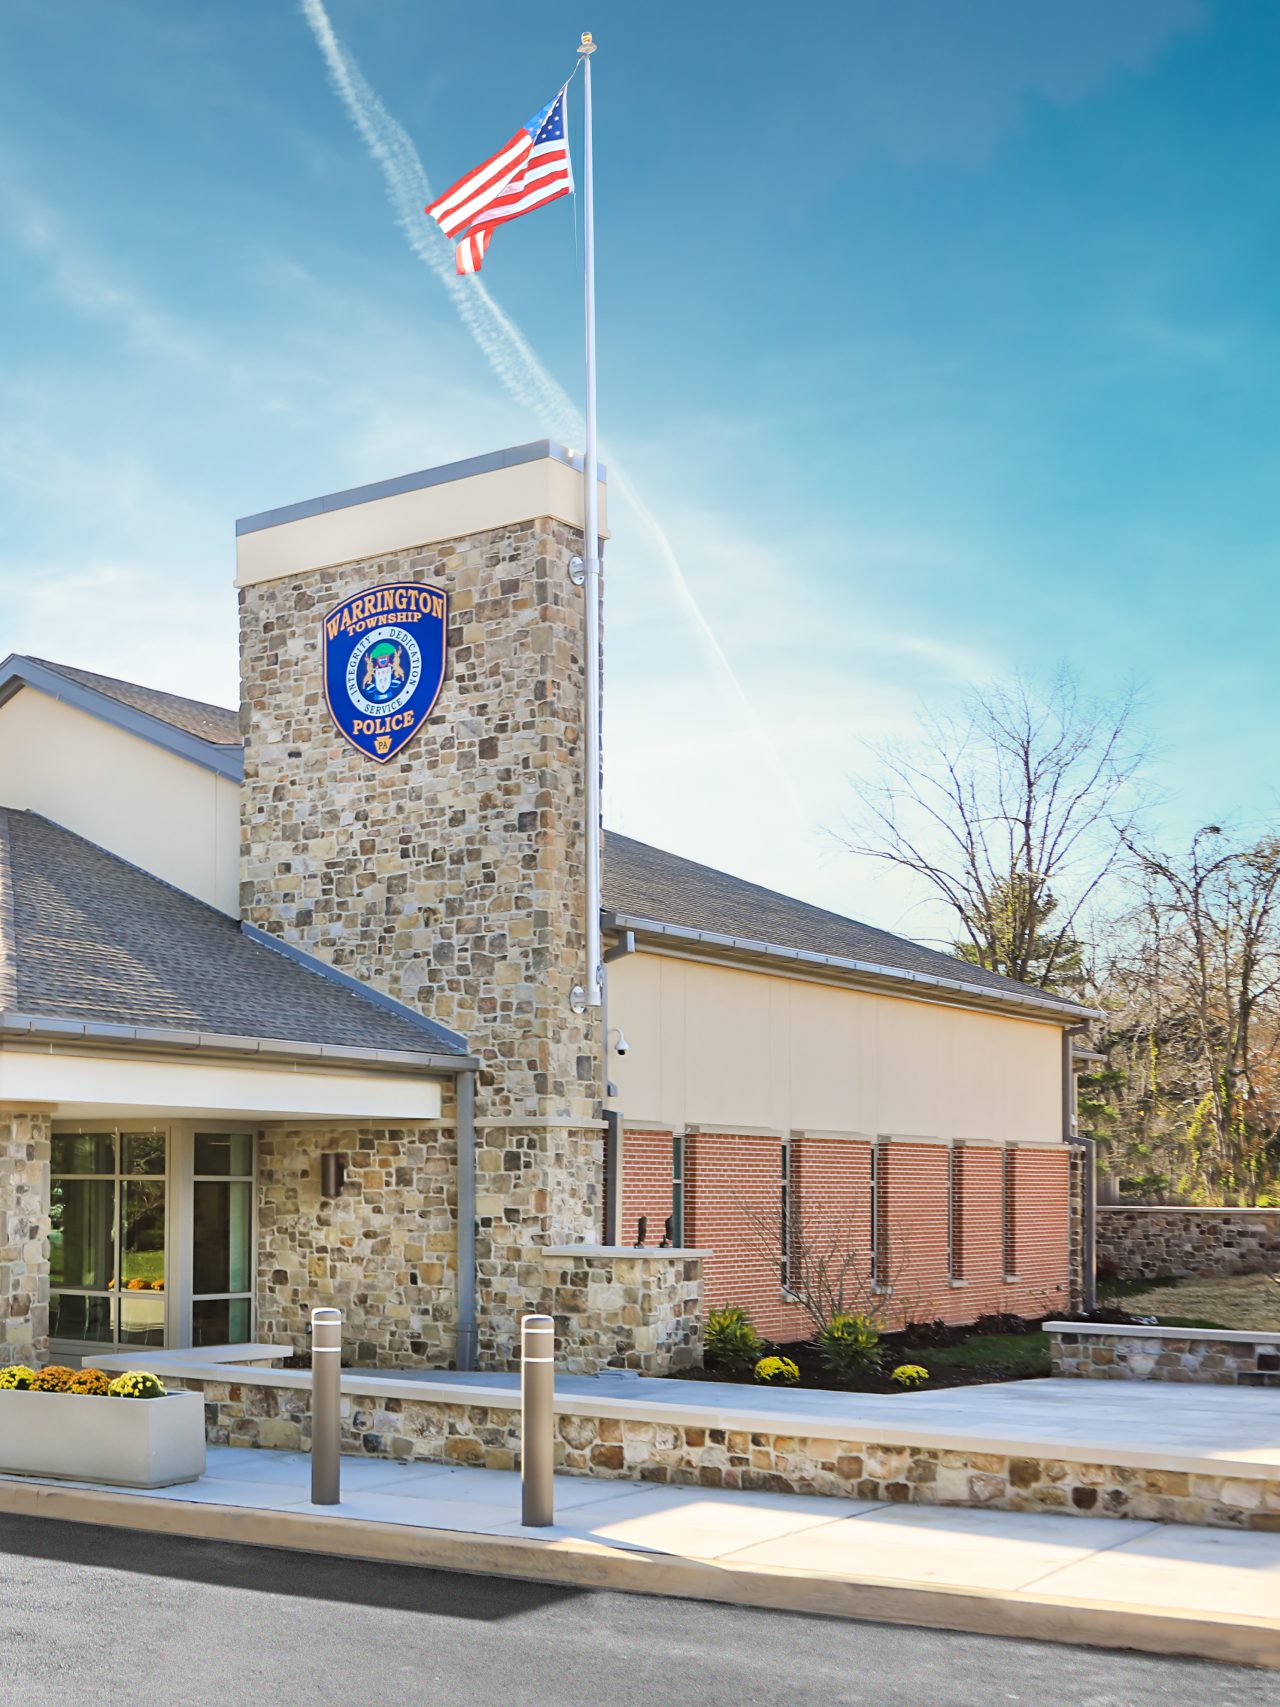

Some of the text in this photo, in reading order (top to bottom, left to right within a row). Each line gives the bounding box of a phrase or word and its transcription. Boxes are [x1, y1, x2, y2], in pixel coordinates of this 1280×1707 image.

[326, 589, 443, 640] WARRINGTON
[347, 612, 422, 637] TOWNSHIP
[348, 635, 372, 696] INTEGRITY
[389, 629, 419, 686] DEDICATION
[364, 697, 403, 715] SERVICE
[353, 711, 414, 734] POLICE
[378, 741, 388, 750] PA
